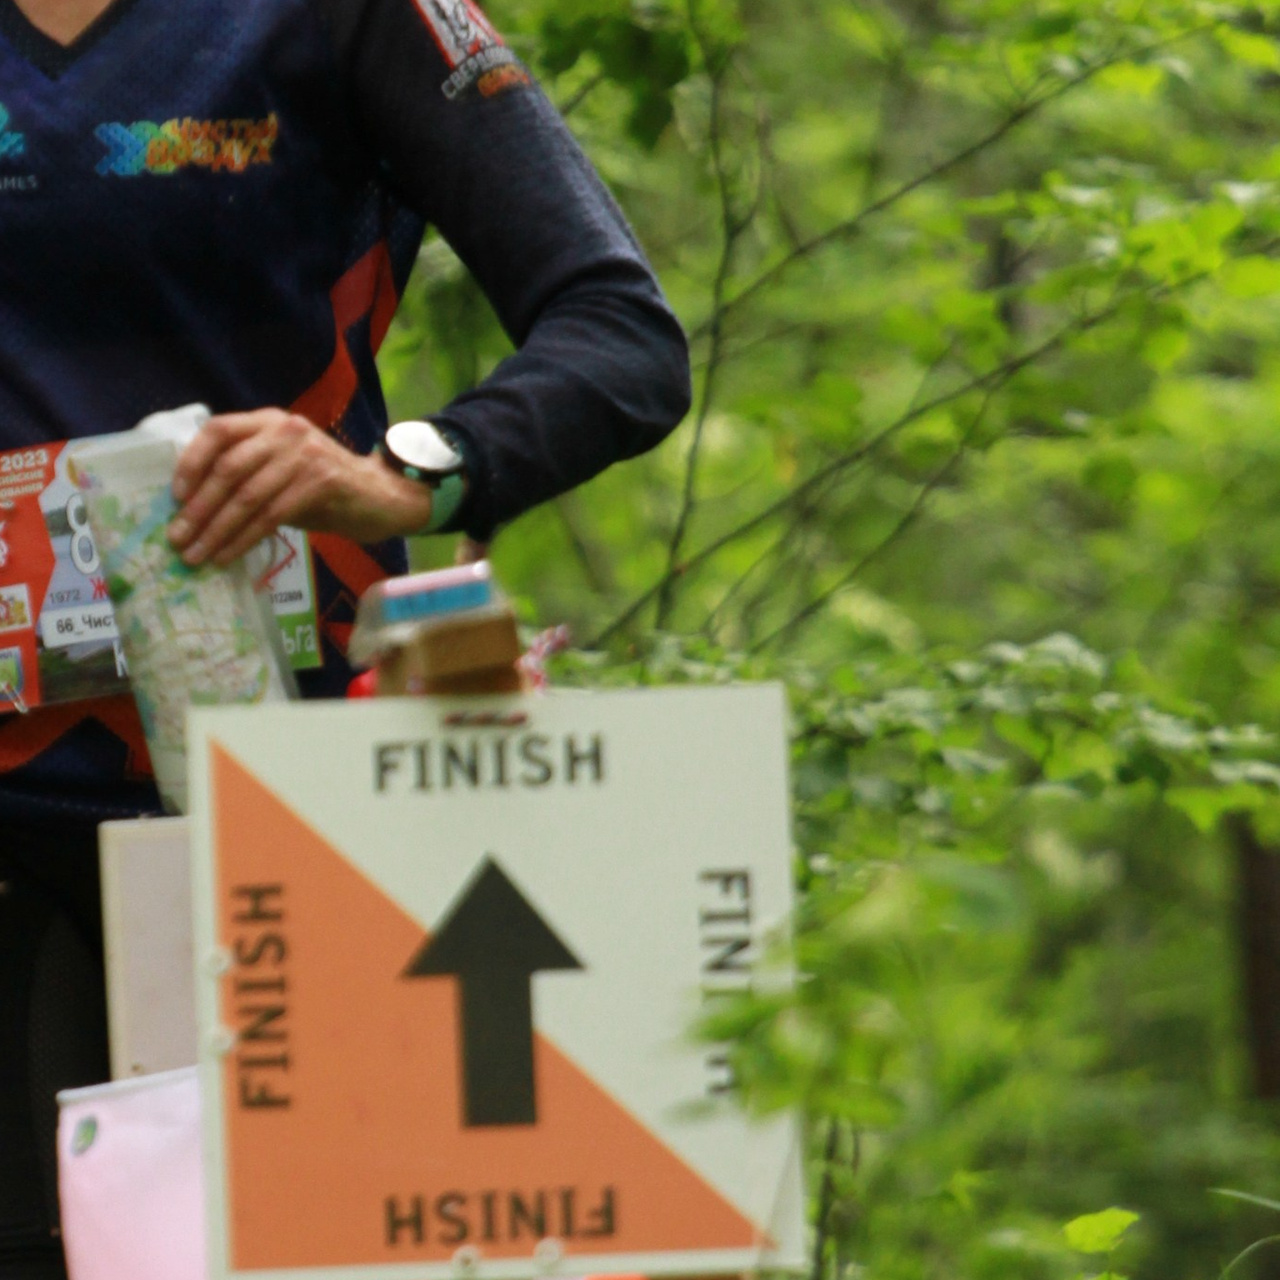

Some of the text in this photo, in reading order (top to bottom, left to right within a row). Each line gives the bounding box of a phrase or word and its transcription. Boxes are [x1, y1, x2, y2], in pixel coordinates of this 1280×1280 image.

[0, 448, 48, 472] 2023
[50, 588, 81, 605] 1972
[56, 614, 115, 638] 66_Чис
[374, 733, 606, 793] FINISH
[232, 883, 291, 1110] FINISH
[384, 1185, 616, 1247] FINISH
